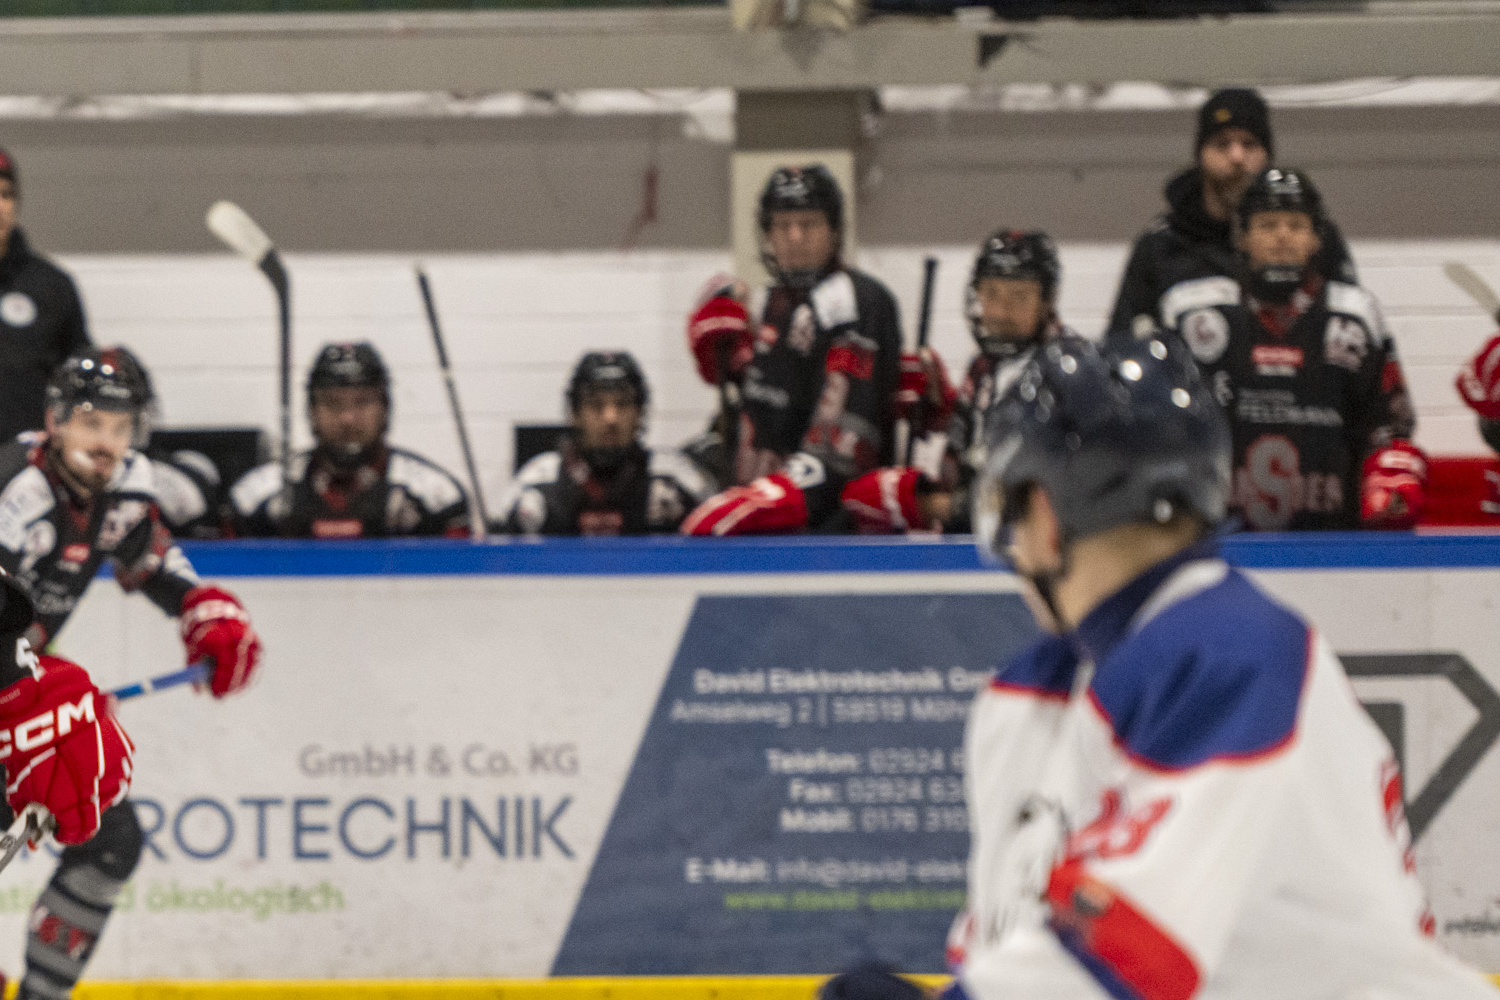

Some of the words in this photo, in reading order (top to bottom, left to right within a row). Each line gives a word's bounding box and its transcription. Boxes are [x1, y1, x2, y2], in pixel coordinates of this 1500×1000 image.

[298, 744, 415, 778] GmbH
[427, 745, 451, 778] &
[462, 743, 519, 778] Co.
[529, 743, 580, 778] KG
